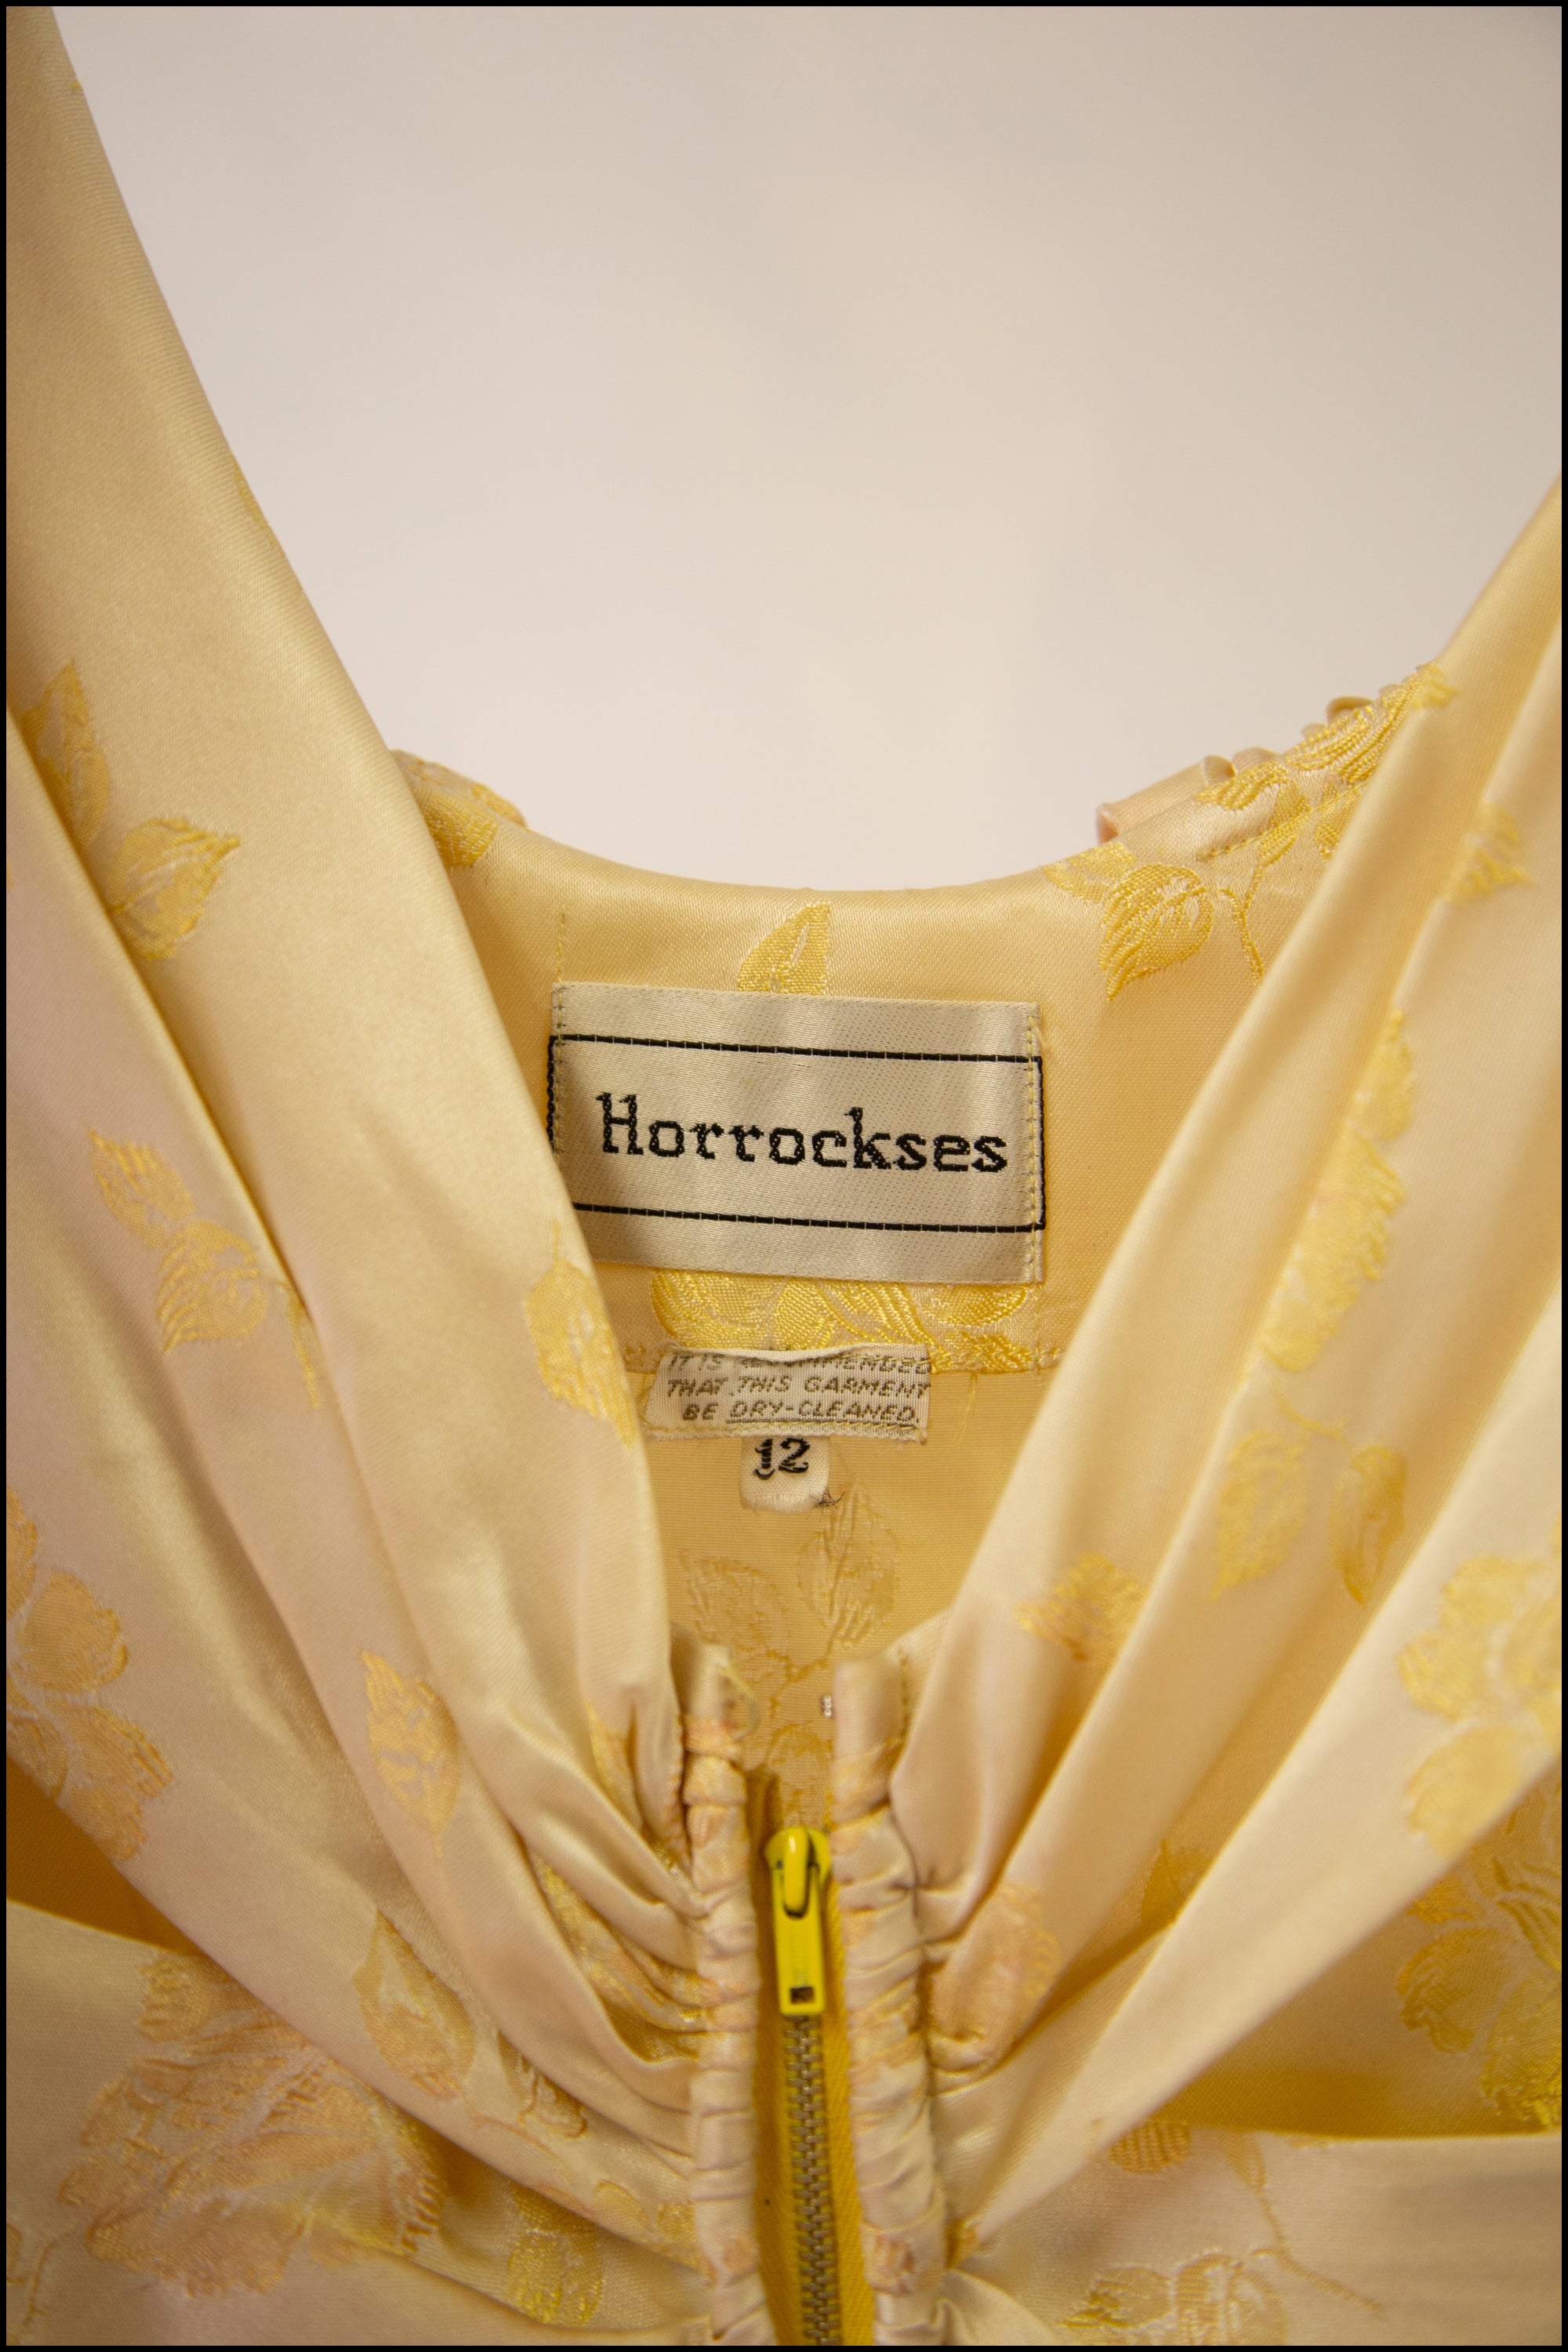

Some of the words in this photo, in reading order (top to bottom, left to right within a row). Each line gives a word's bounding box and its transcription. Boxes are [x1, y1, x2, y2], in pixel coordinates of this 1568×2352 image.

[595, 1091, 1008, 1174] Horrockses
[669, 1354, 694, 1370] IT
[668, 1377, 728, 1397] THAT
[738, 1376, 793, 1393] THIS
[804, 1377, 931, 1399] GARMENT
[683, 1402, 719, 1421] BE
[730, 1401, 920, 1424] DRY-CLEANED.
[754, 1437, 811, 1480] 12
